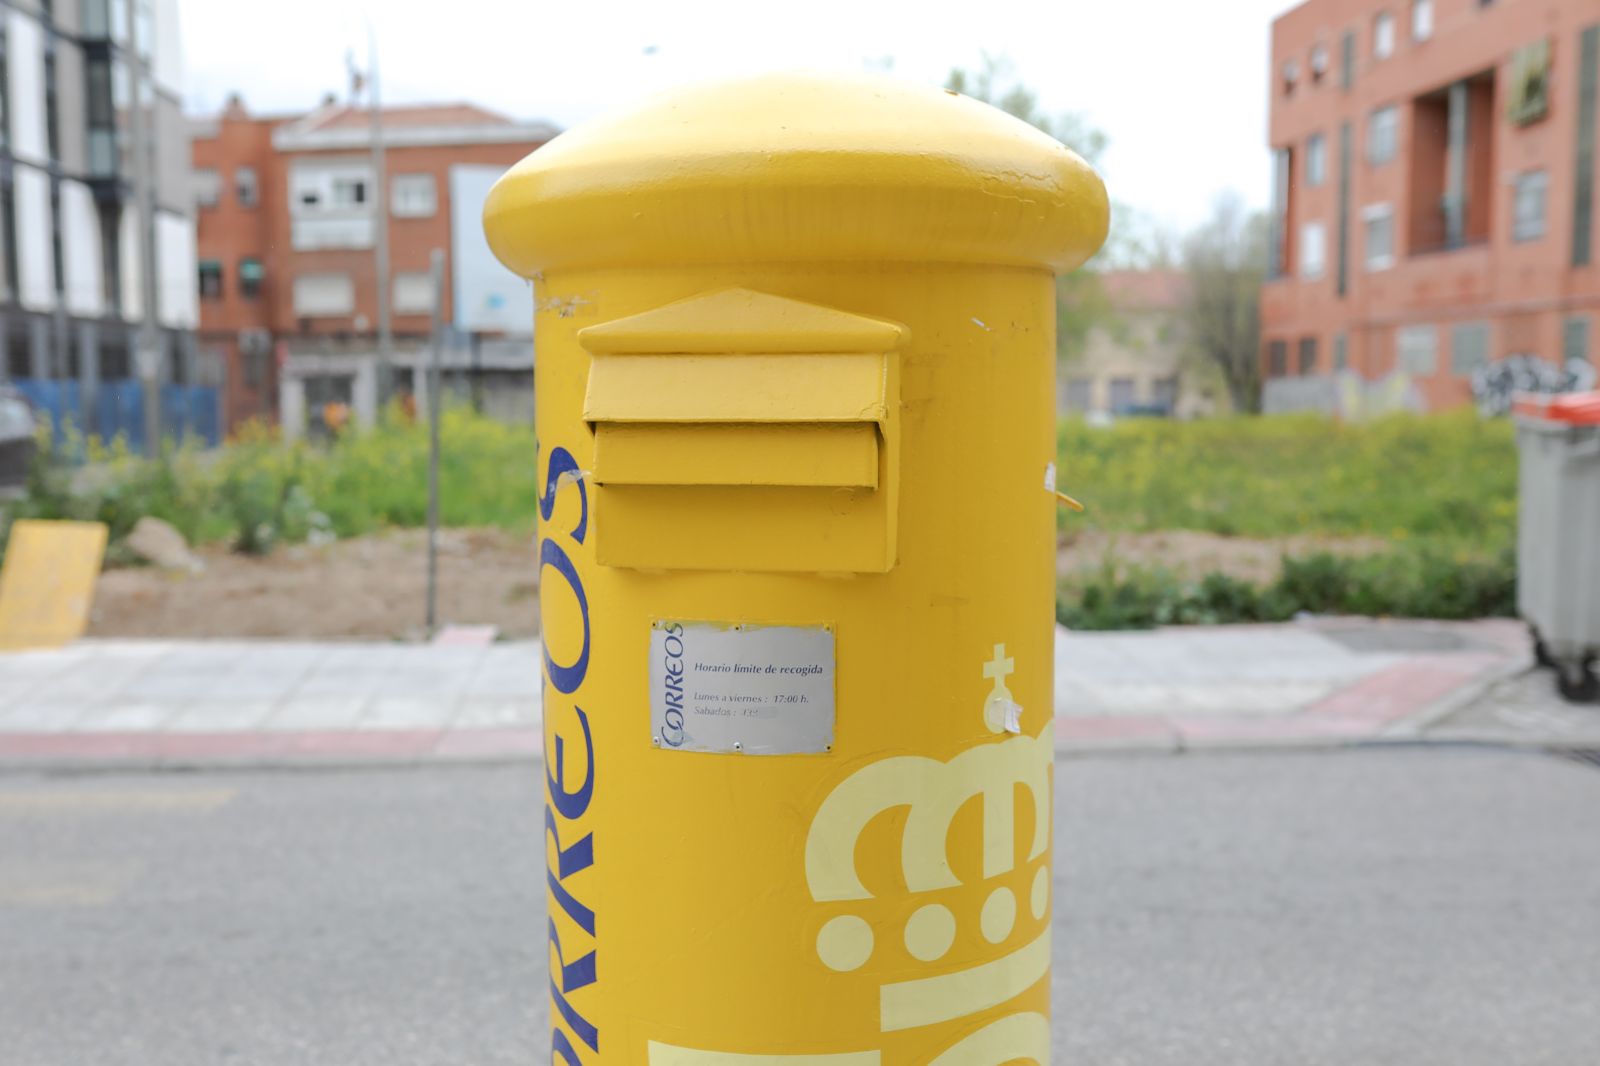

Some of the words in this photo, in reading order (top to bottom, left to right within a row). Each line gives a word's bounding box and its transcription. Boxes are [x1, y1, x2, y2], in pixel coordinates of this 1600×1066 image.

[694, 662, 731, 673] Horario
[764, 664, 777, 674] de
[779, 664, 823, 677] recogida
[661, 622, 684, 747] CORREOS
[693, 692, 719, 702] Lunes
[729, 694, 762, 703] viernes
[774, 694, 798, 703] 17:00
[800, 694, 809, 703] h.
